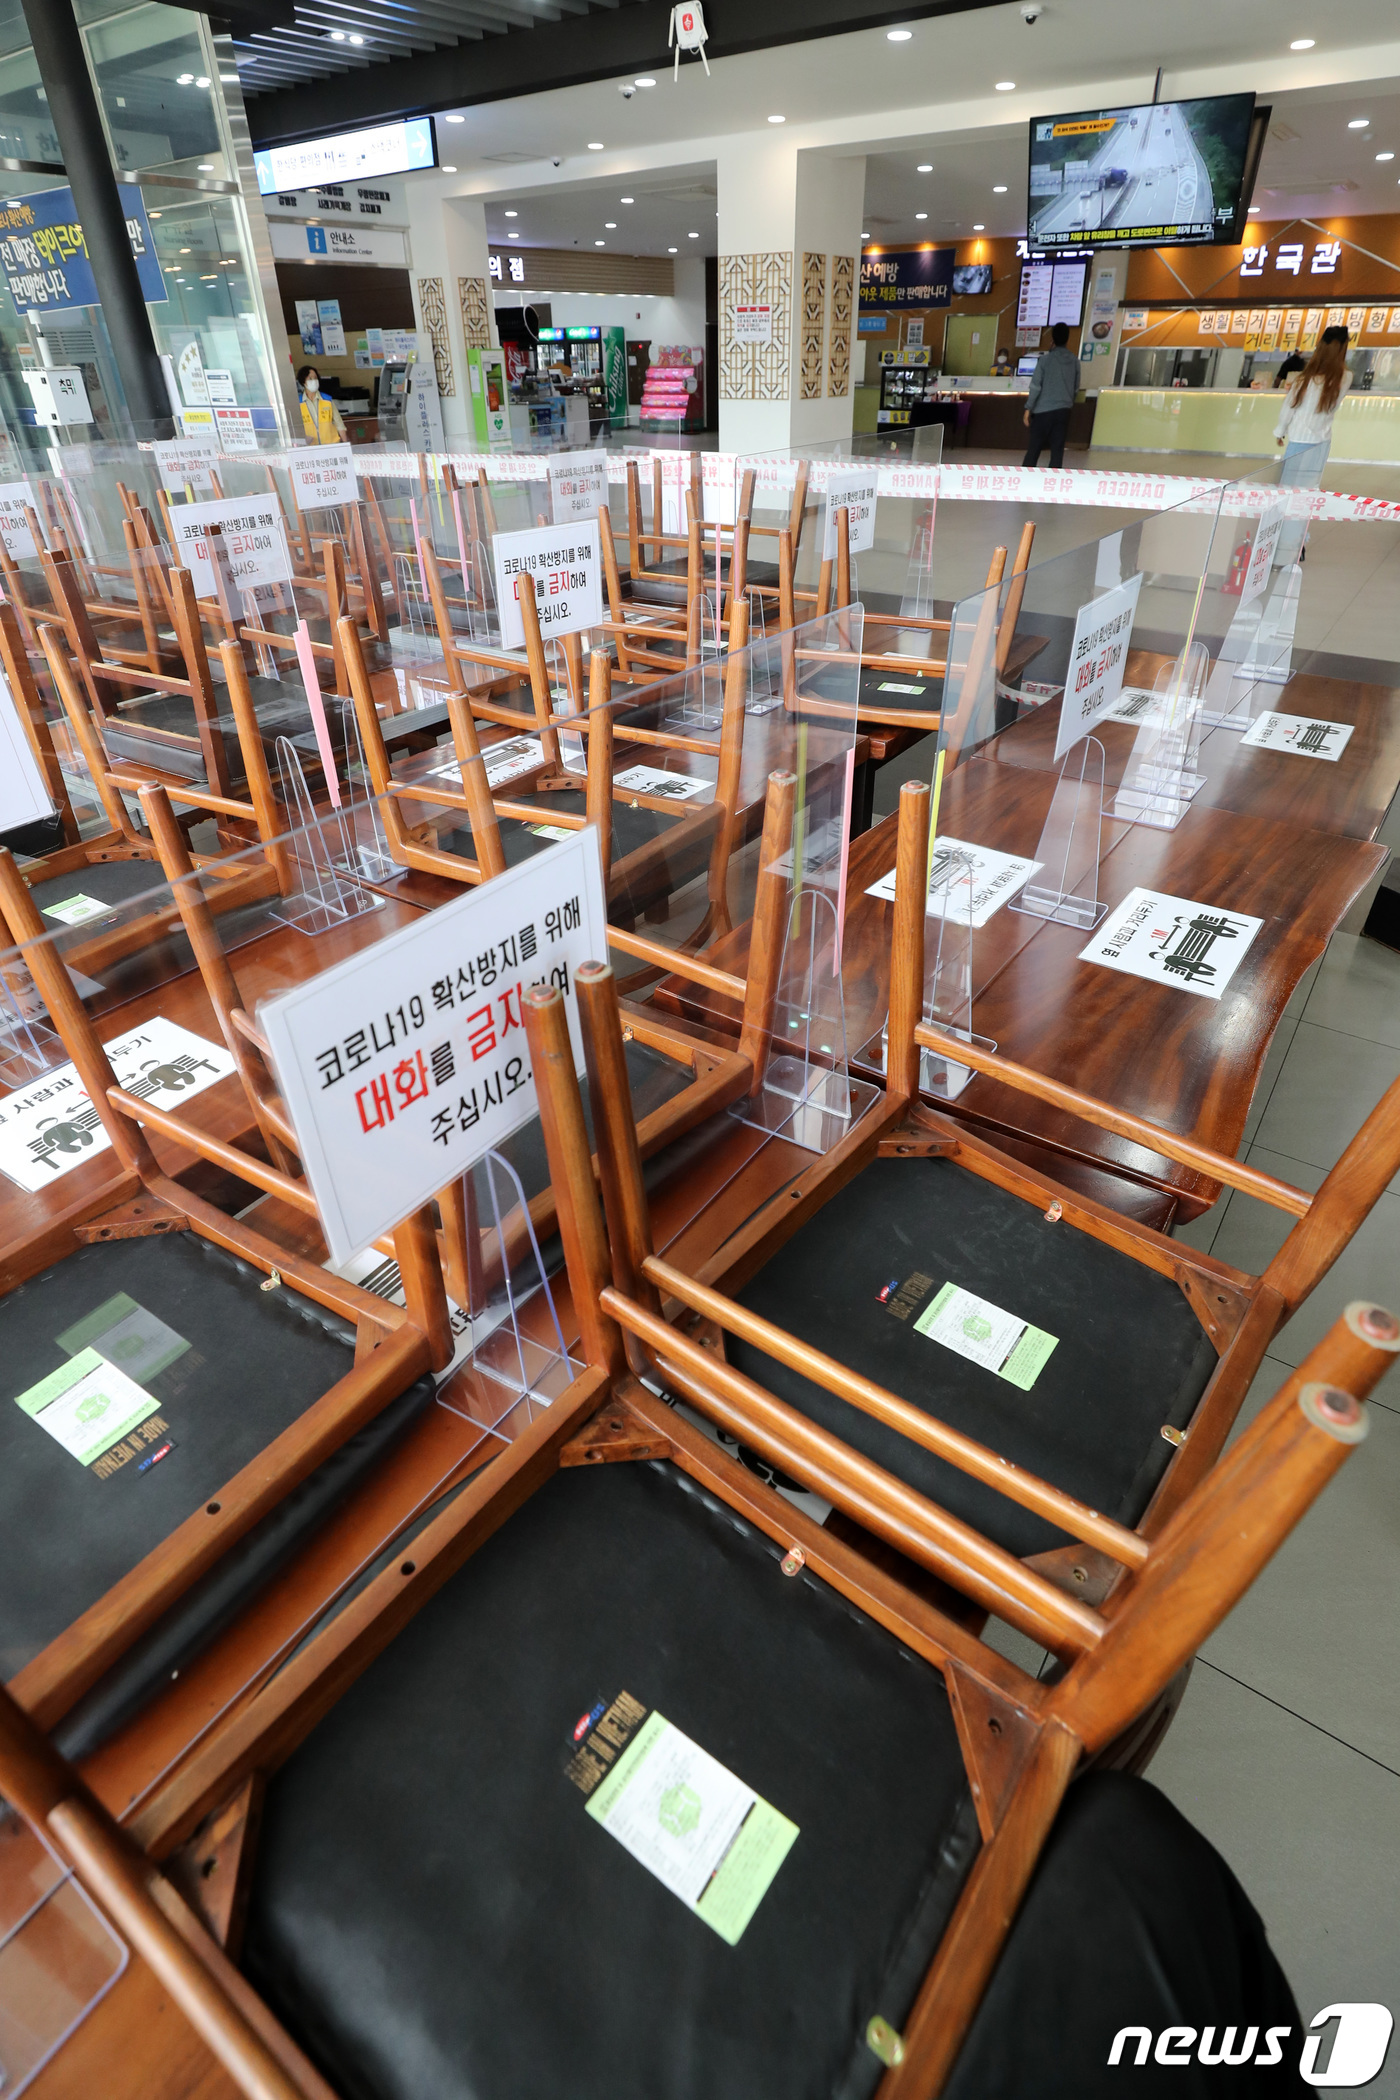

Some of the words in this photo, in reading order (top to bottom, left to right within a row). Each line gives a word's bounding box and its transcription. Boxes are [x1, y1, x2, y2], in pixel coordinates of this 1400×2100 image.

[1, 241, 17, 271] 전
[12, 237, 42, 269] 매장
[32, 223, 90, 265] 테이크아
[329, 231, 355, 246] 안내소
[332, 247, 358, 256] Information
[358, 248, 373, 257] Center
[1239, 241, 1342, 277] 한국관
[9, 268, 71, 305] 판매합니다
[906, 284, 948, 299] 판매합니다
[294, 459, 316, 470] 코로나19
[315, 457, 339, 469] 확산방지를
[338, 456, 349, 466] 위해
[301, 471, 322, 485] 대화를
[322, 469, 348, 483] 금지하여
[560, 480, 578, 496] 대화를
[866, 487, 874, 499] 위해
[257, 513, 274, 526] 위해
[231, 534, 273, 555] 금지하여
[231, 559, 260, 578] 십시오.
[503, 554, 537, 575] 코로나19
[538, 547, 576, 569] 확산방지를
[577, 544, 592, 562] 위해
[548, 570, 587, 596] 금지하여
[1121, 607, 1133, 631] 위해
[1074, 658, 1097, 694] 대화를
[1096, 642, 1123, 680] 금지하여
[1108, 925, 1138, 950] 사람과
[1125, 899, 1159, 928] 거리두기
[1150, 928, 1170, 941] 1M
[315, 994, 426, 1091] 코로나19
[430, 923, 539, 1012] 확산방지를
[543, 894, 582, 944] 위해
[354, 1040, 456, 1135] 대화를
[466, 961, 570, 1063] 금지여
[12, 1077, 75, 1115] 사람과
[430, 1056, 533, 1147] 주십시오.
[137, 1414, 170, 1444] MADE
[126, 1434, 146, 1453] IN
[90, 1441, 137, 1481] VIETNAM
